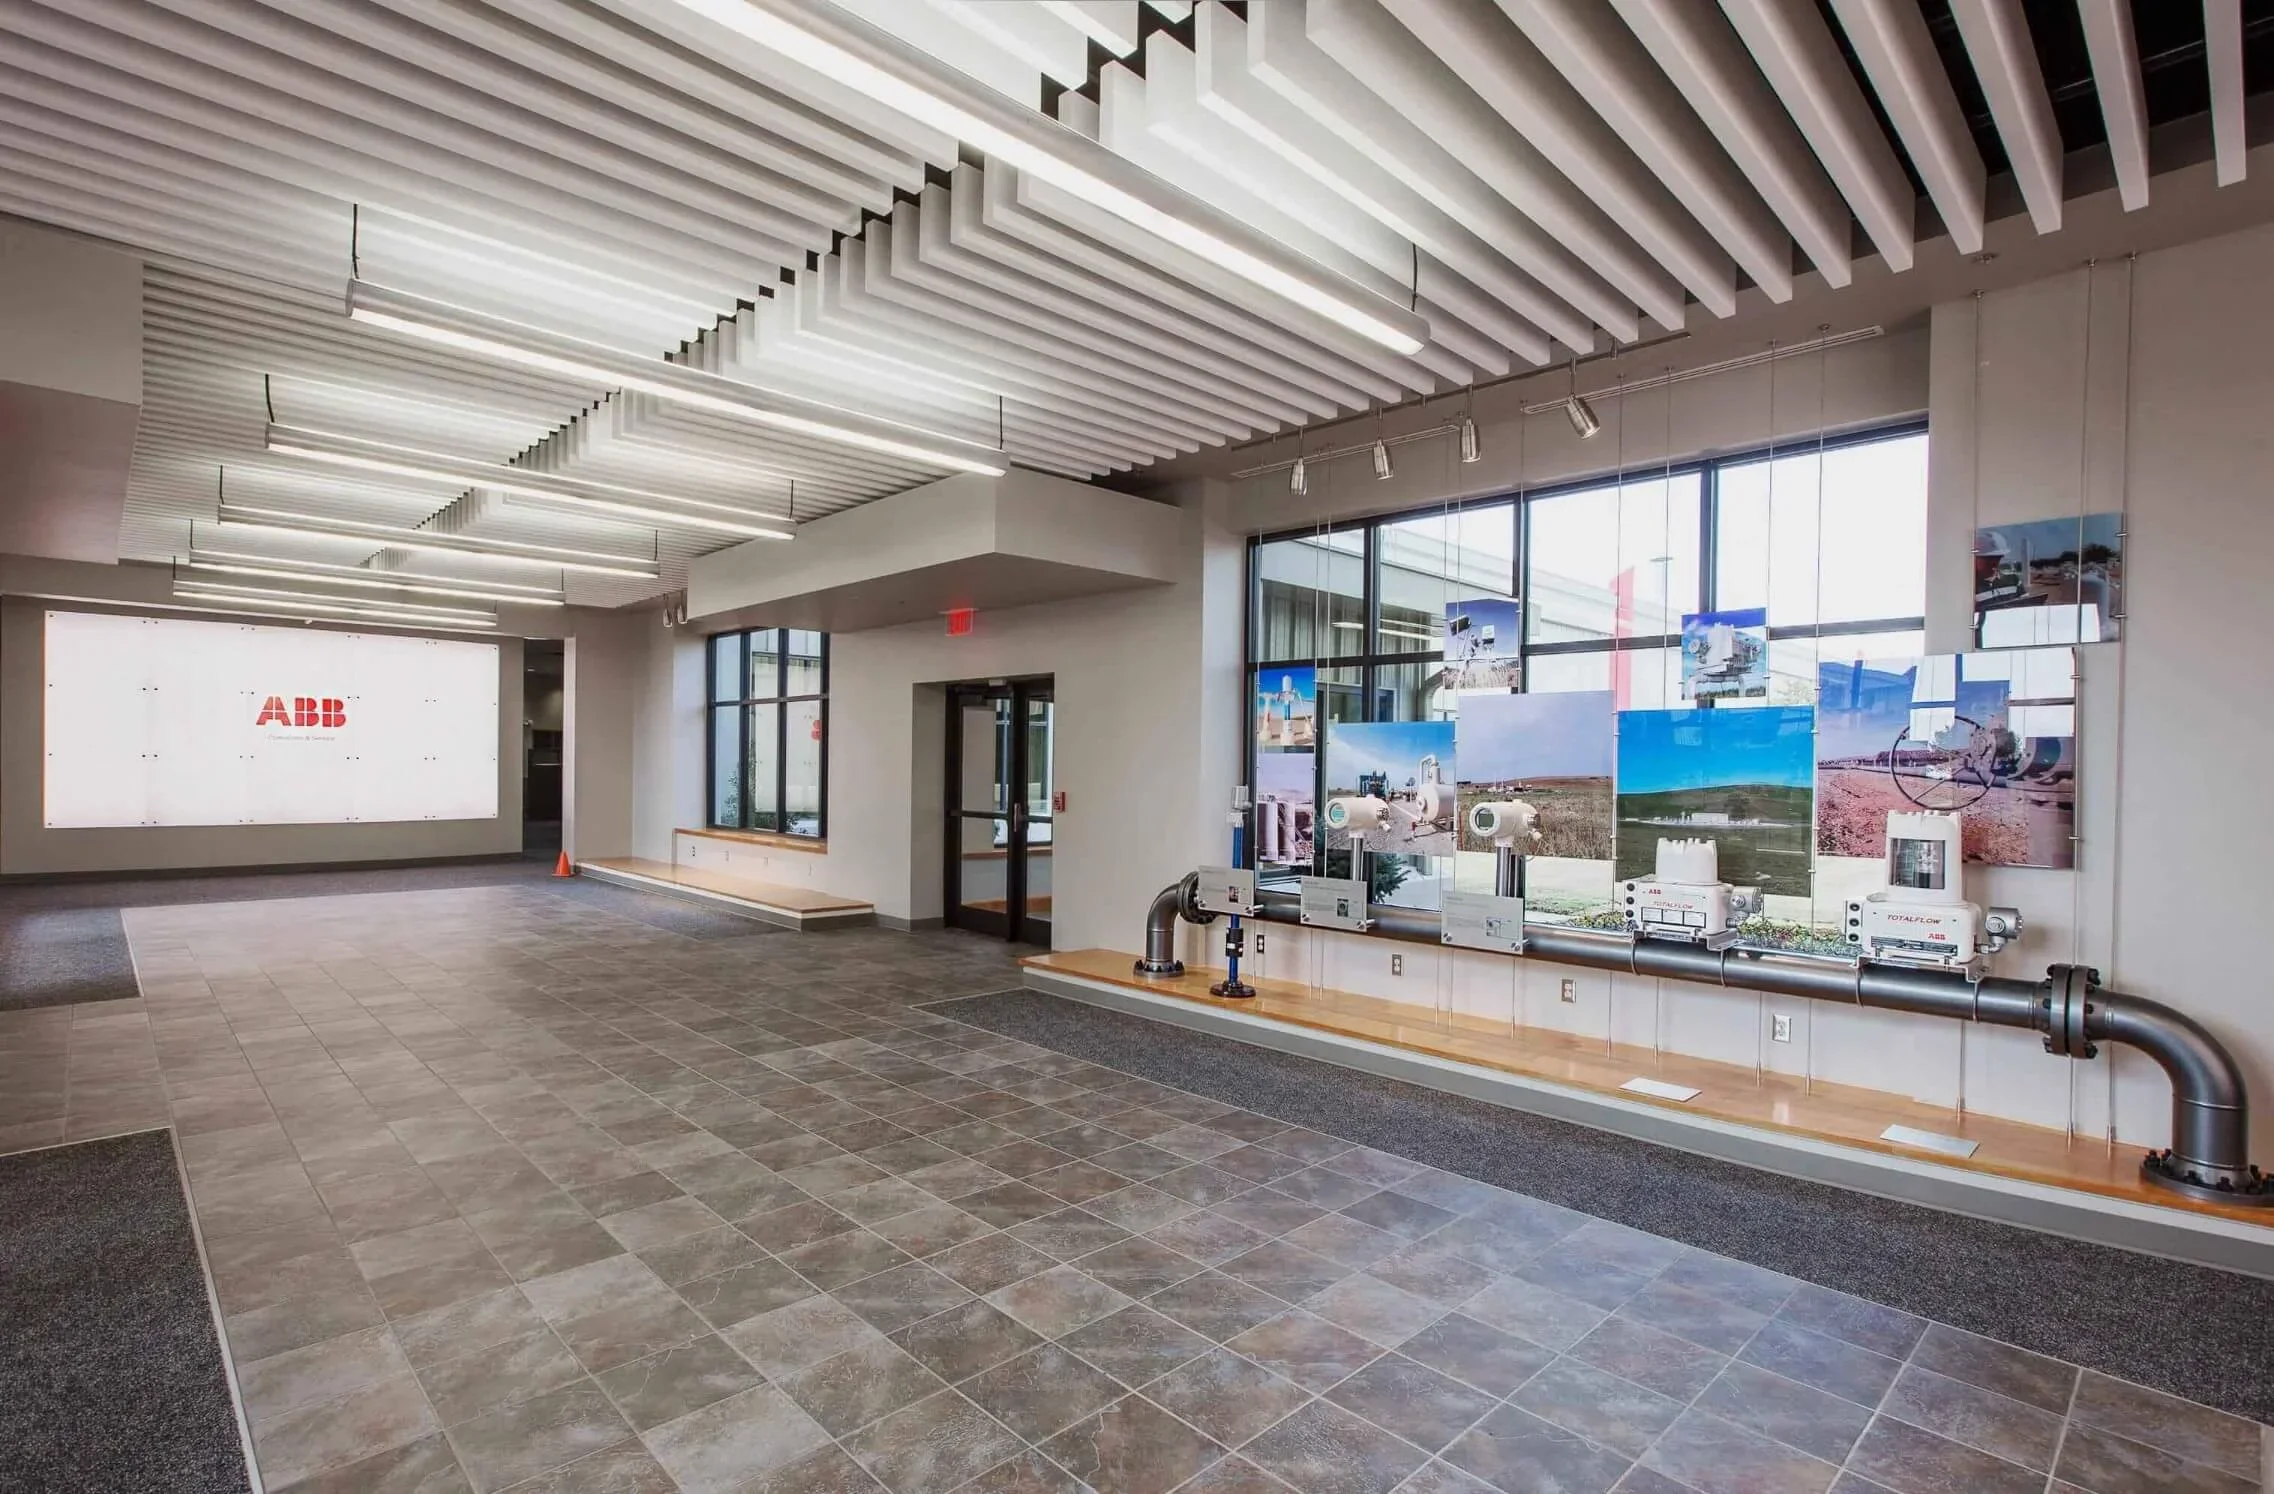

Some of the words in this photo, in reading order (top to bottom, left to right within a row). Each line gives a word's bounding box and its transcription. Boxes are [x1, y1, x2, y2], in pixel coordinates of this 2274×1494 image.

[256, 696, 346, 728] ABB
[1653, 900, 1693, 909] TOTALFLOW
[1887, 914, 1941, 924] TOTALFLOW
